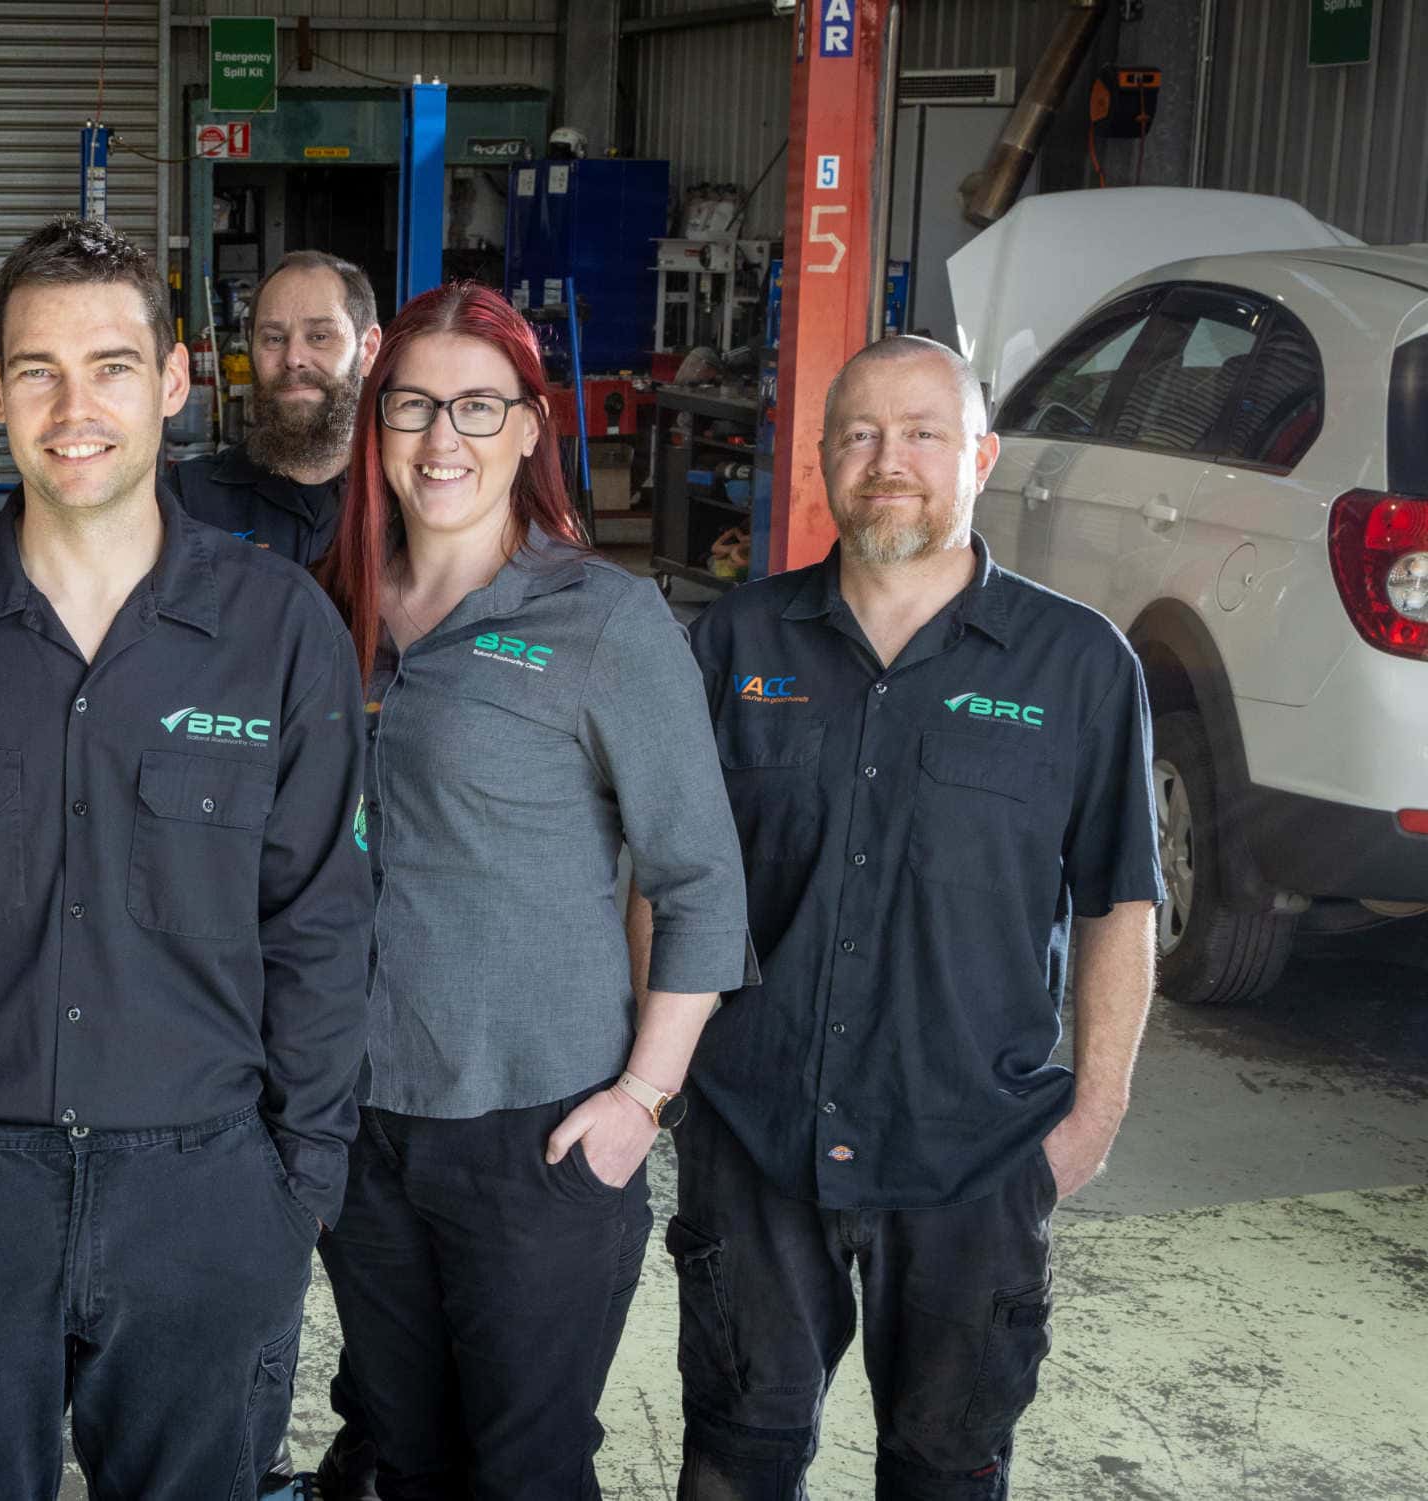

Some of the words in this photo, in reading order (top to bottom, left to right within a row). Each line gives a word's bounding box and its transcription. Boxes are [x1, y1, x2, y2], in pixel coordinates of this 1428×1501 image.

[215, 52, 271, 63] Emergency
[223, 67, 246, 78] Spill
[248, 67, 264, 77] Kit
[822, 158, 835, 185] 5
[807, 205, 847, 273] 5
[475, 632, 554, 666] BRC
[733, 674, 797, 697] VACC
[969, 697, 1044, 726] BRC
[188, 713, 270, 740] BRC
